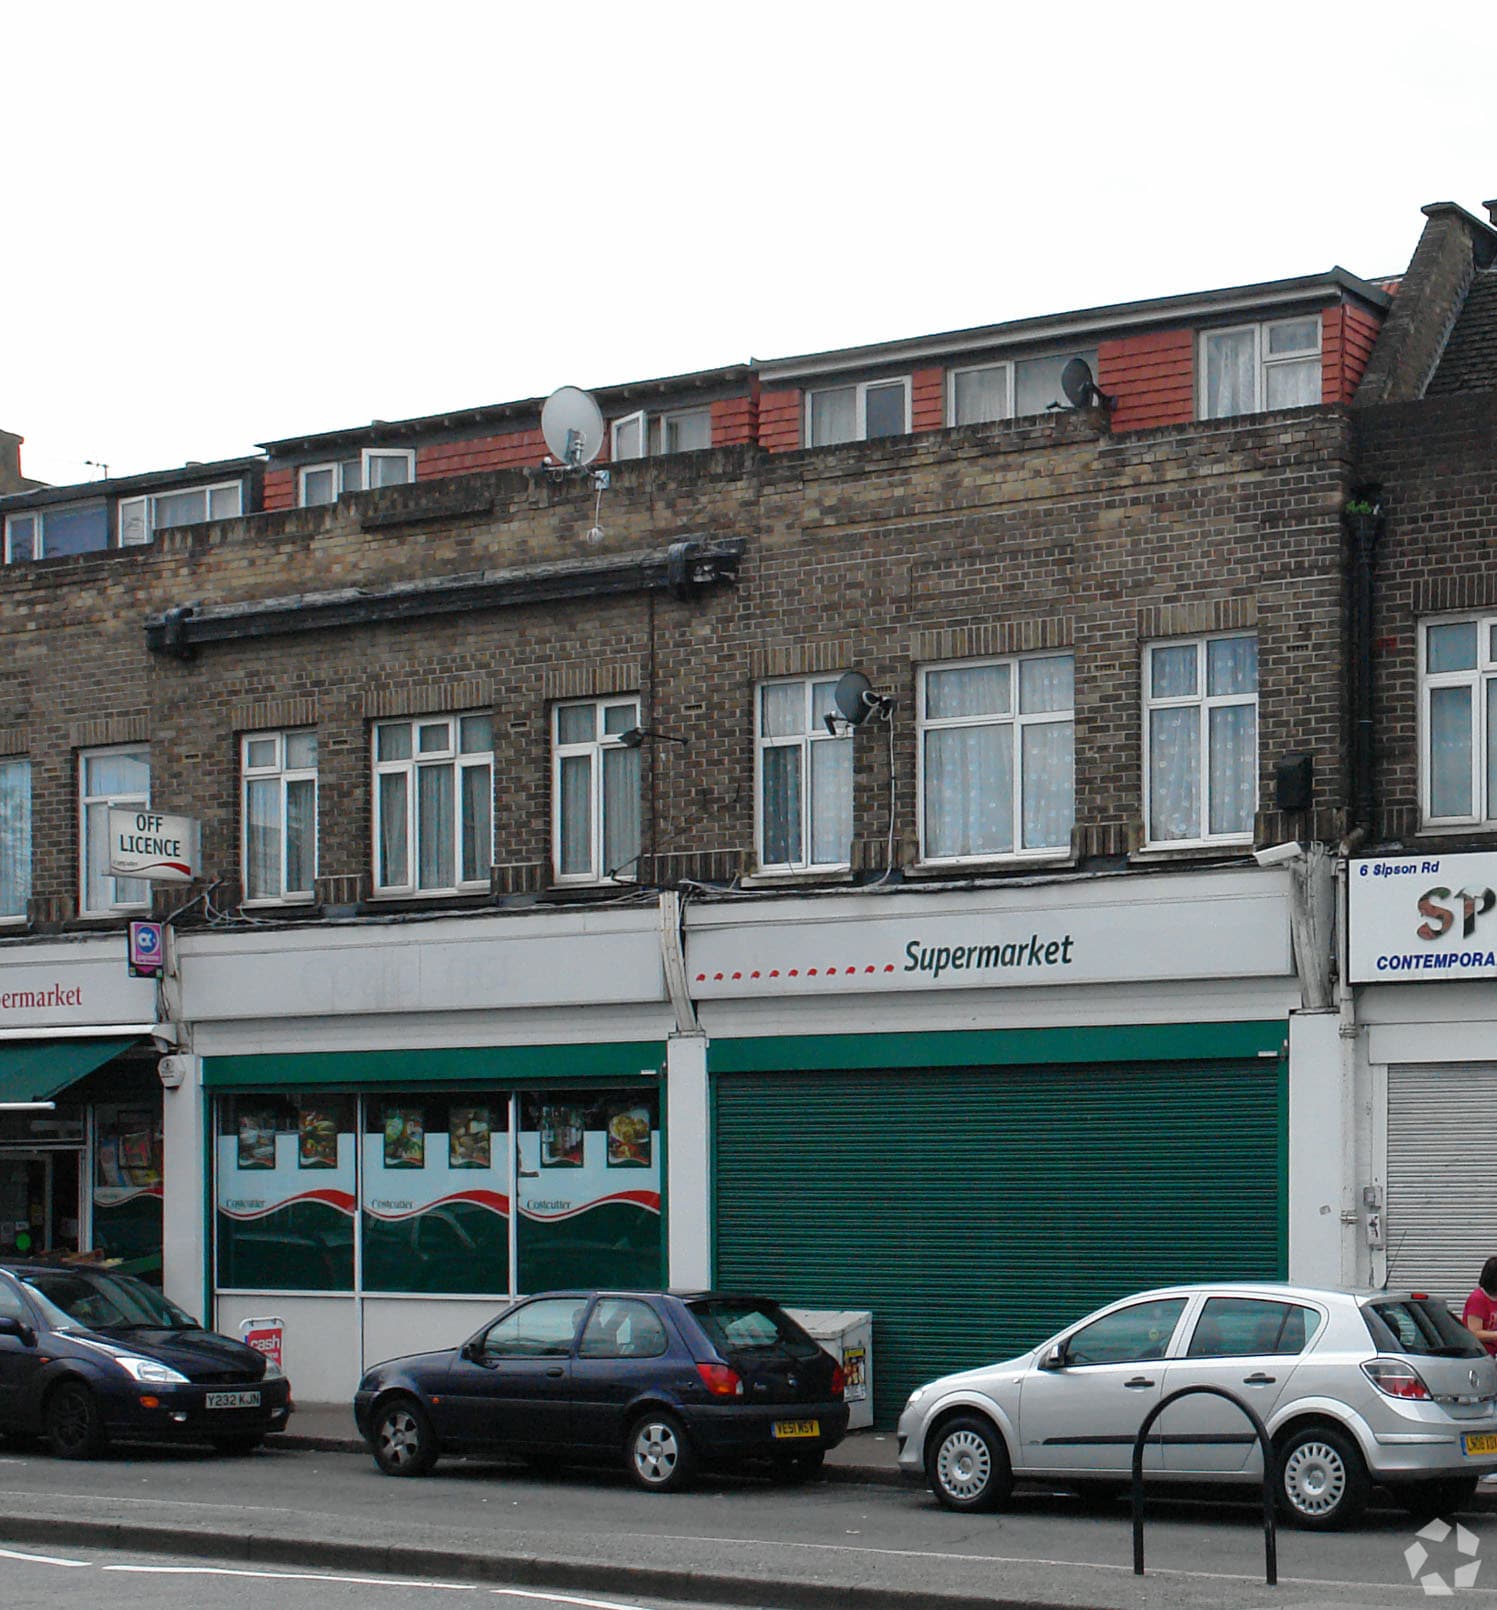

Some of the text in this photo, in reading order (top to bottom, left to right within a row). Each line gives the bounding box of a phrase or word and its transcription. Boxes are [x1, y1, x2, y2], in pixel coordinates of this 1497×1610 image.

[136, 814, 163, 833] OFF
[120, 834, 181, 858] LICENCE
[1360, 860, 1440, 878] 6 Sipson Rd
[904, 934, 1074, 978] Supermarket
[1376, 951, 1496, 971] CONTEMPORA
[0, 983, 82, 1008] ermarket
[250, 1334, 280, 1351] cash
[207, 1392, 260, 1407] Y232 KJN
